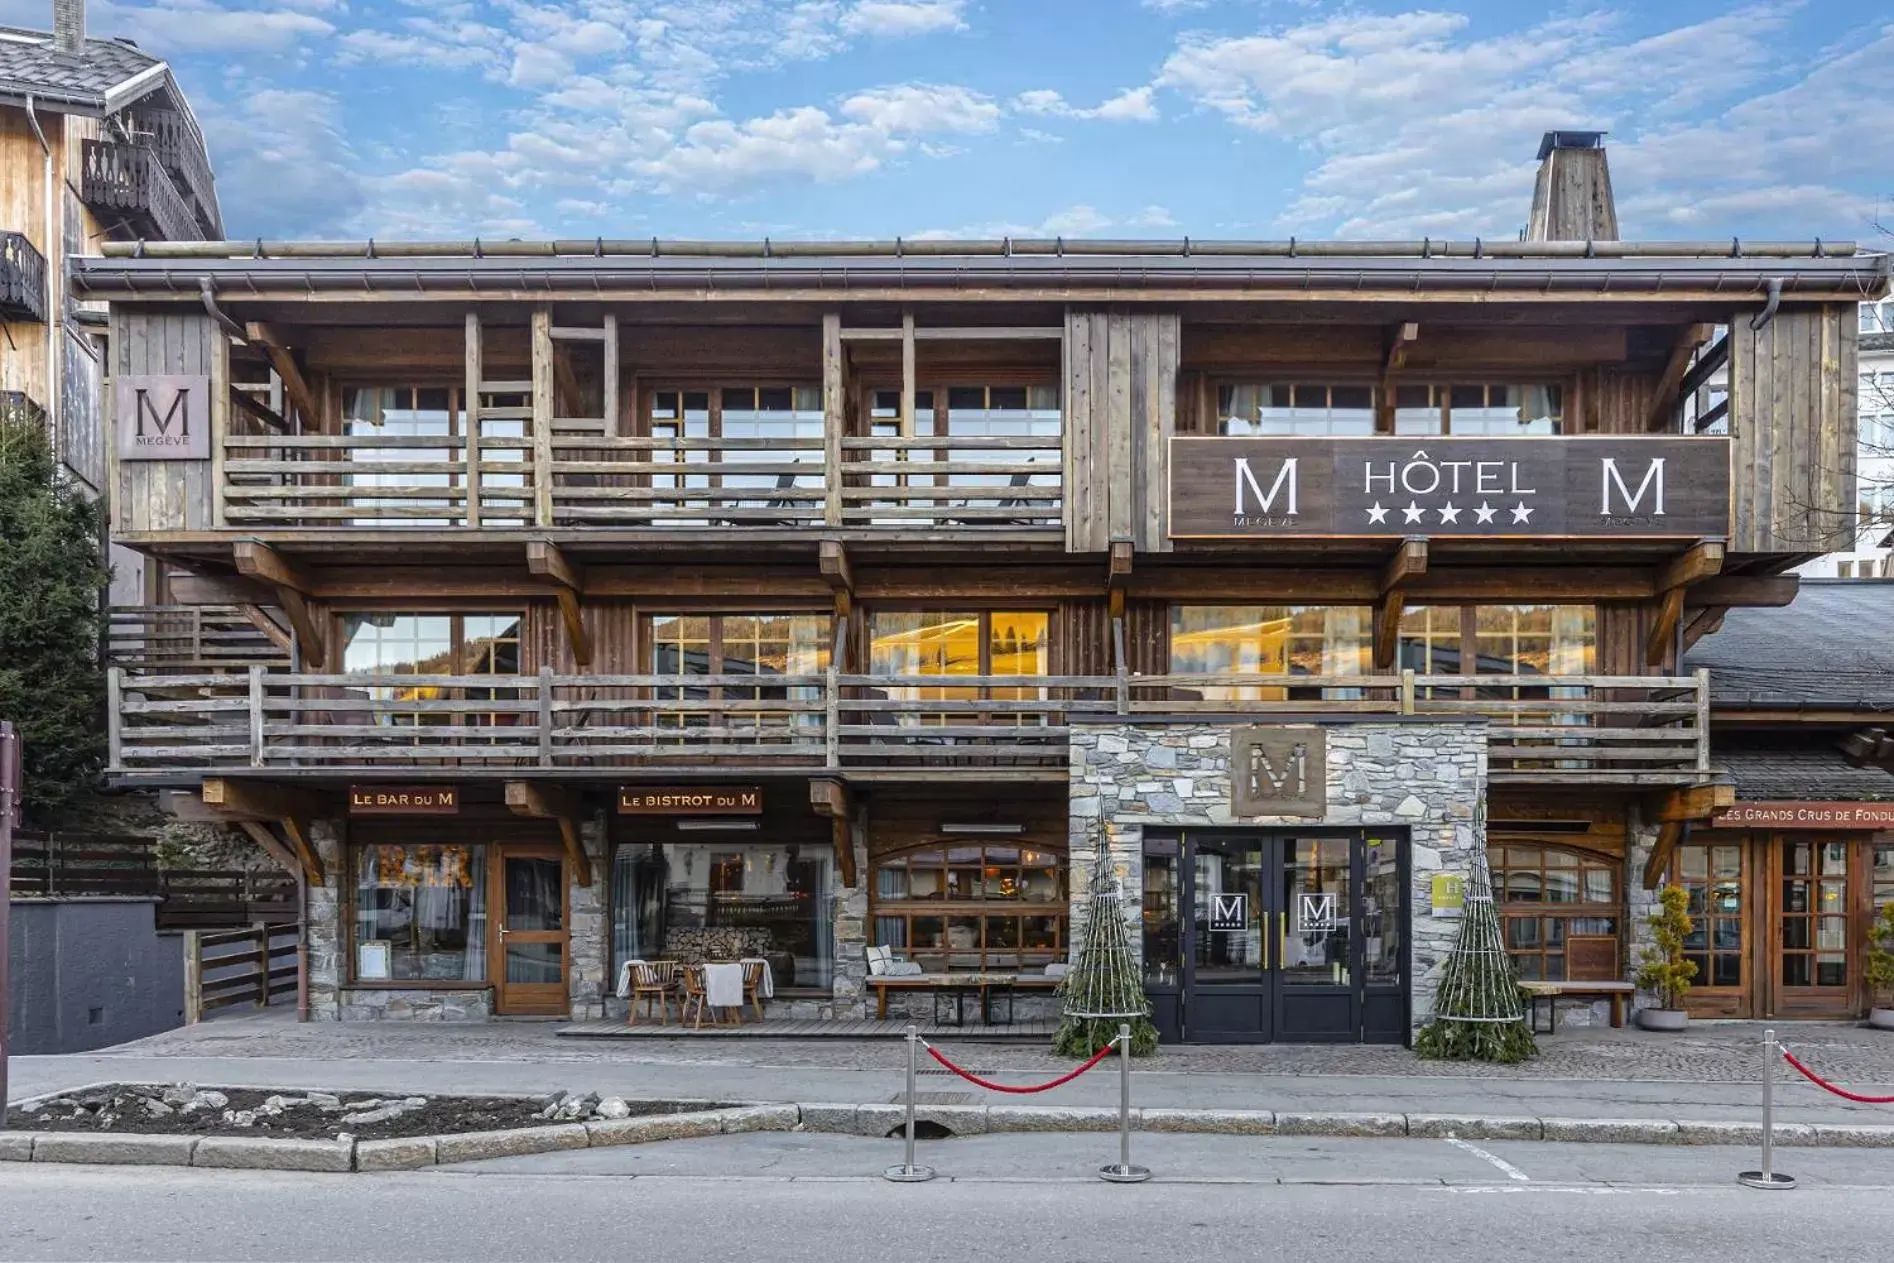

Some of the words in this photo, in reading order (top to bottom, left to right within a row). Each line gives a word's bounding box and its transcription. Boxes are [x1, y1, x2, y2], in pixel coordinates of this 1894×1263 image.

[135, 388, 190, 436] M
[1233, 457, 1298, 514] M
[1364, 450, 1536, 494] HÔTEL
[1600, 457, 1666, 514] M
[1250, 743, 1307, 800] M
[377, 794, 409, 805] BAR
[439, 793, 453, 805] M
[645, 795, 713, 807] BISTROT
[741, 793, 755, 806] M
[1214, 896, 1242, 921] M
[1303, 896, 1331, 921] M
